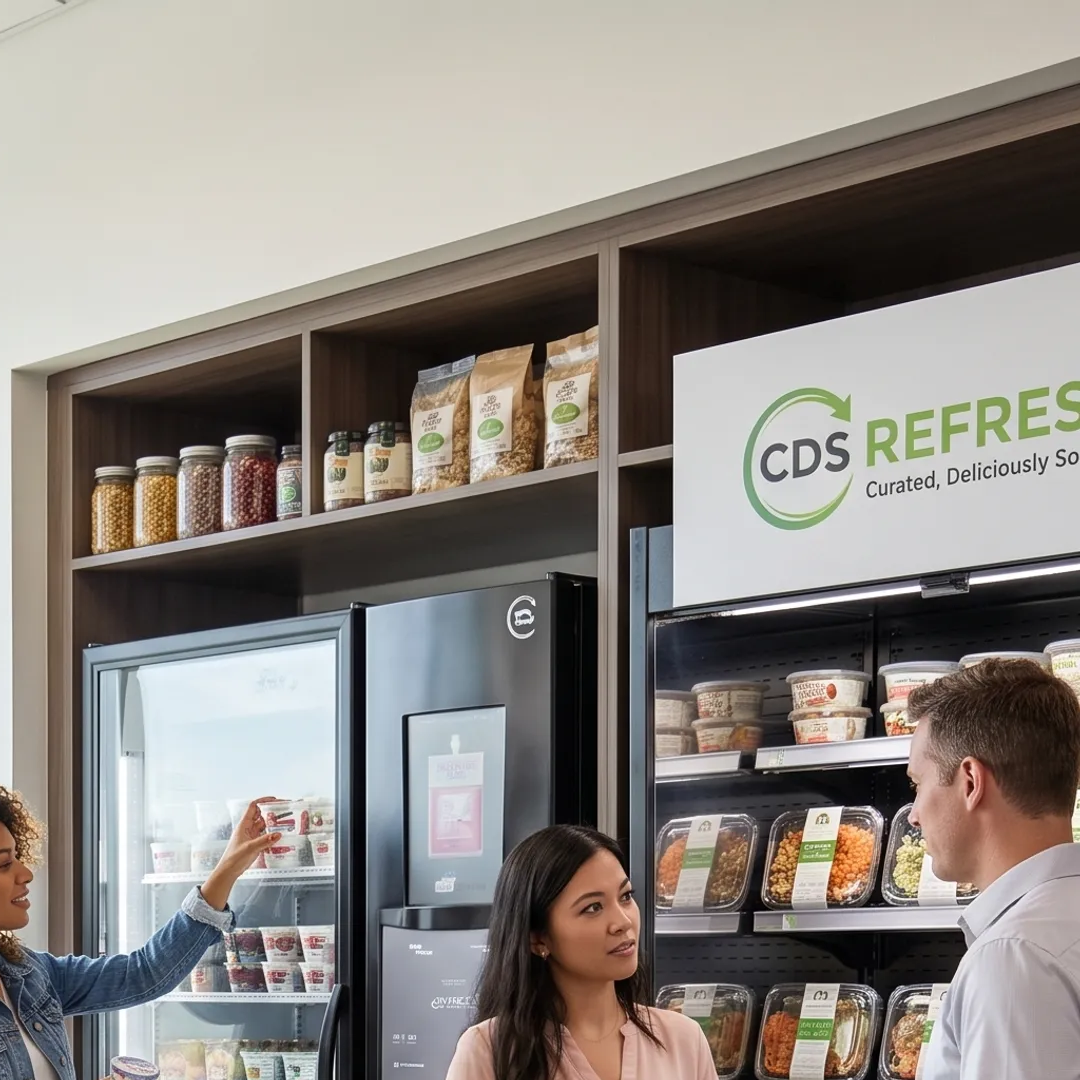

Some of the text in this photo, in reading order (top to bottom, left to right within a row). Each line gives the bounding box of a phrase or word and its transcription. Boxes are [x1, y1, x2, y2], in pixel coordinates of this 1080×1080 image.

[760, 380, 1080, 483] CDS REFRES
[865, 448, 1080, 499] Curated, Deliciously So
